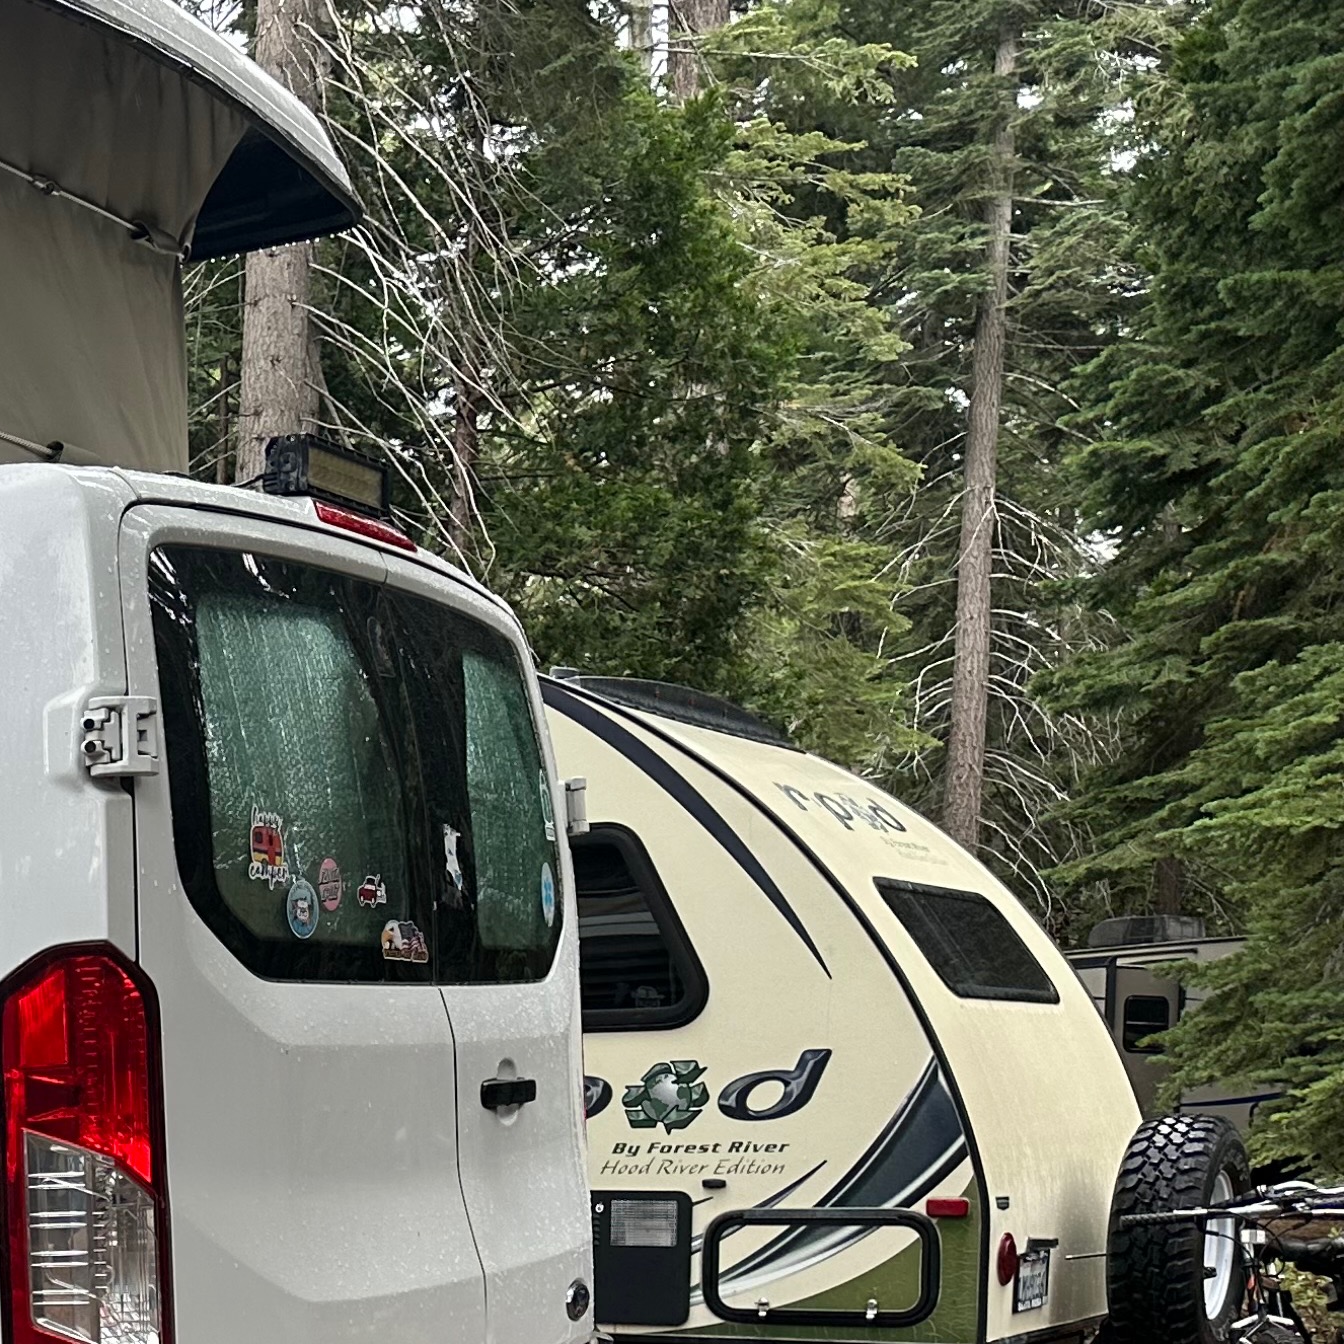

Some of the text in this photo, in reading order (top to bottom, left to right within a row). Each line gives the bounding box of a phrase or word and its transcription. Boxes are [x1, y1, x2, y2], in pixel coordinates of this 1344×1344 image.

[612, 1142, 790, 1157] By Forest River
[601, 1157, 786, 1175] Hood River Edition
